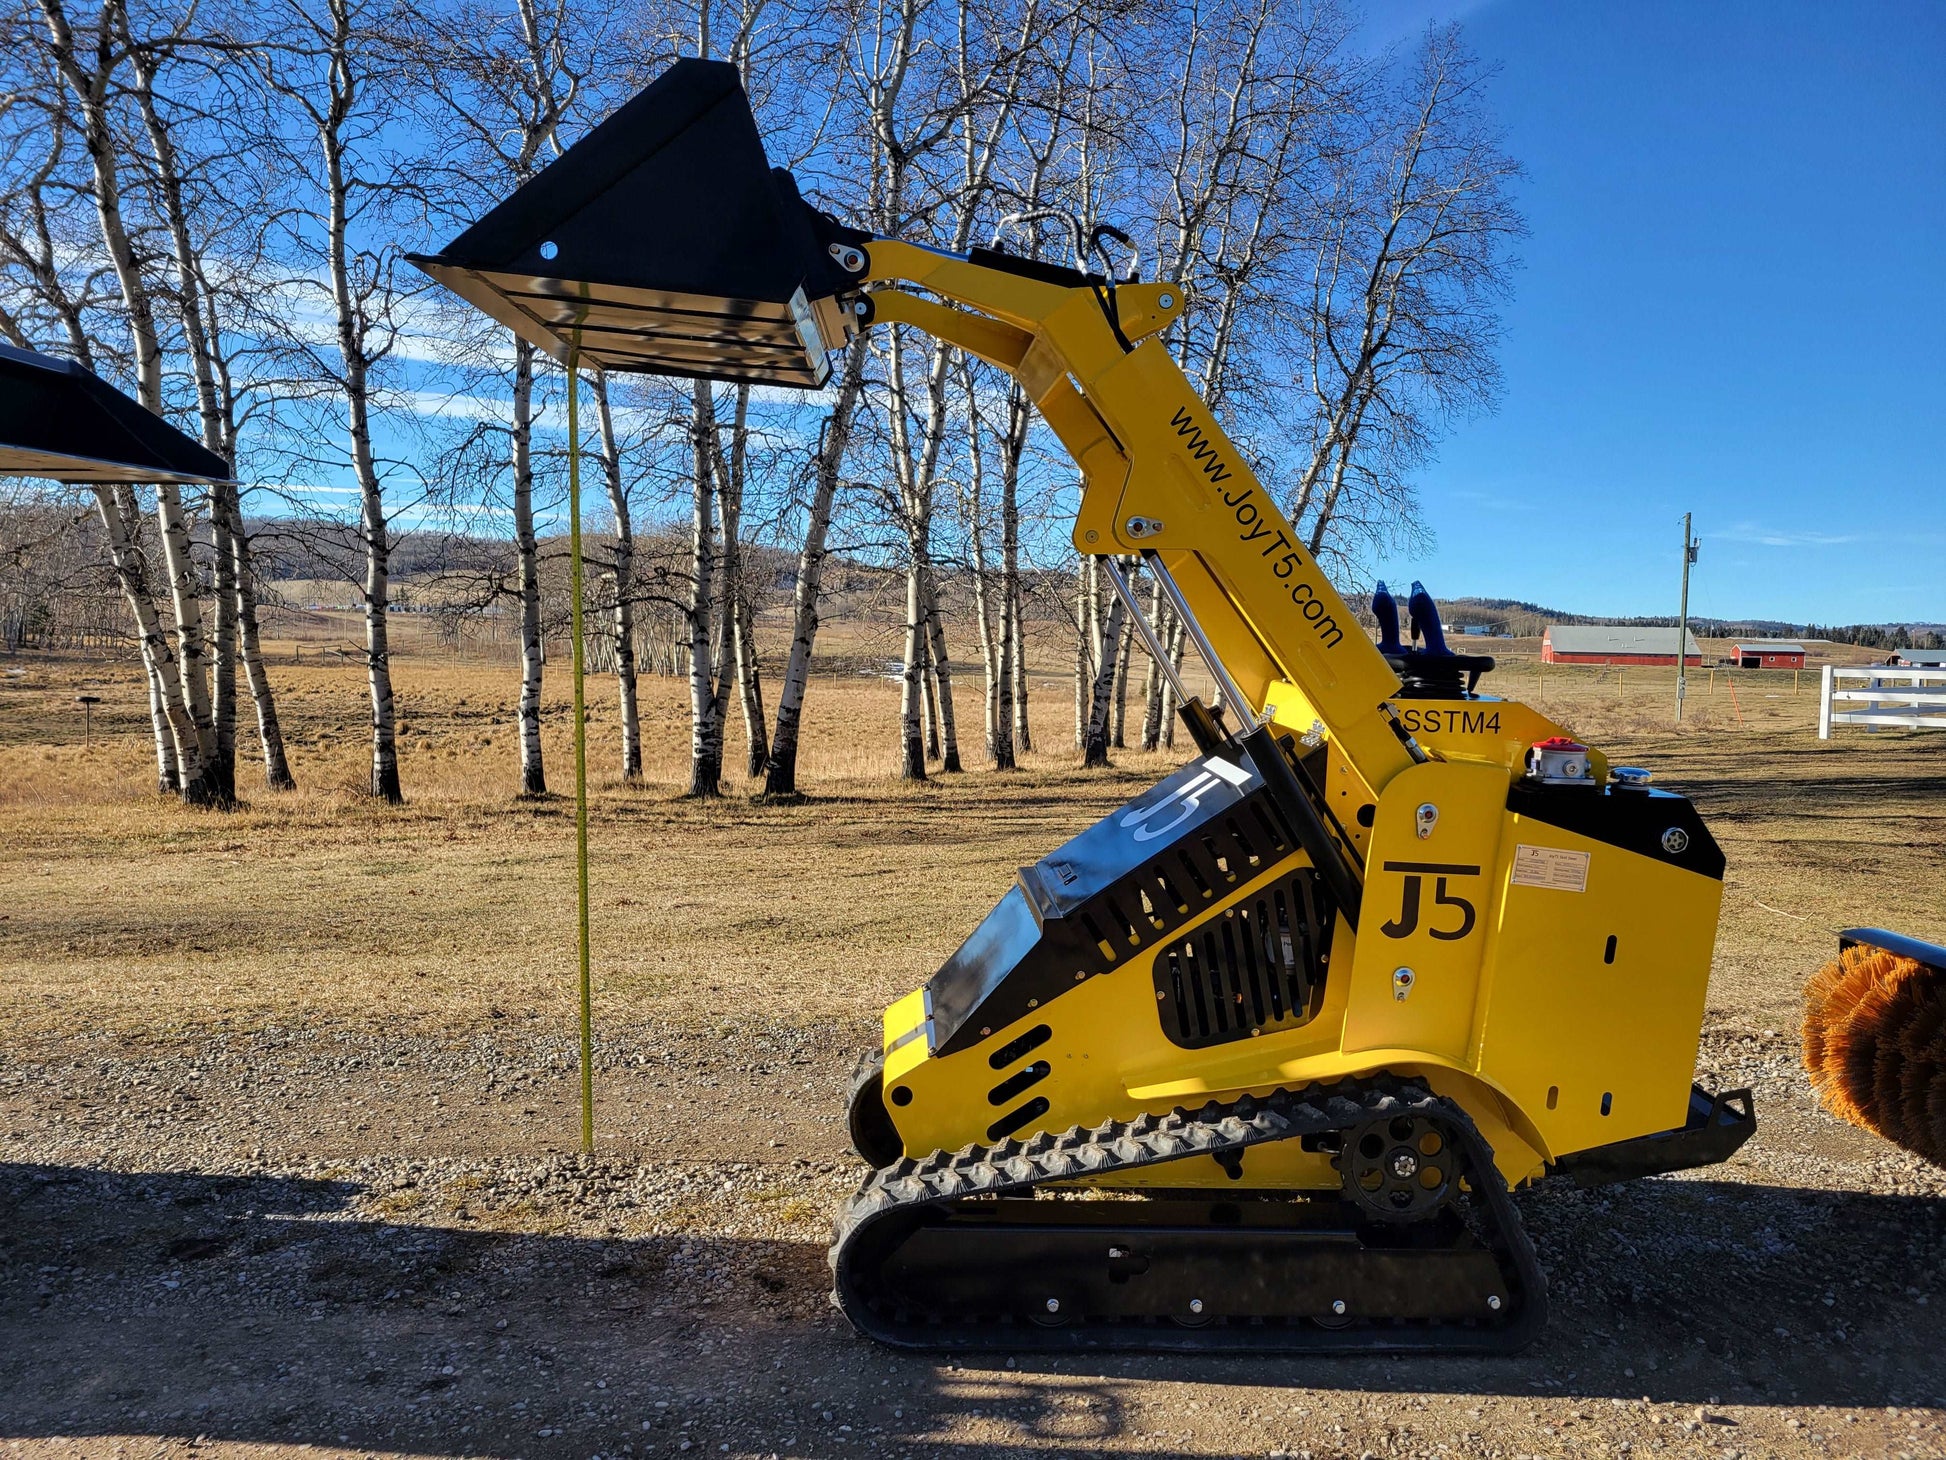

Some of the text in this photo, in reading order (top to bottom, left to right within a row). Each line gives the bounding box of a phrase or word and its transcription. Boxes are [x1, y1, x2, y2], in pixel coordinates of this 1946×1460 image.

[1170, 406, 1344, 649] www.JoyT5.com
[1397, 709, 1501, 734] SSTM4
[1120, 756, 1253, 842] J5
[1380, 861, 1480, 940] J5
